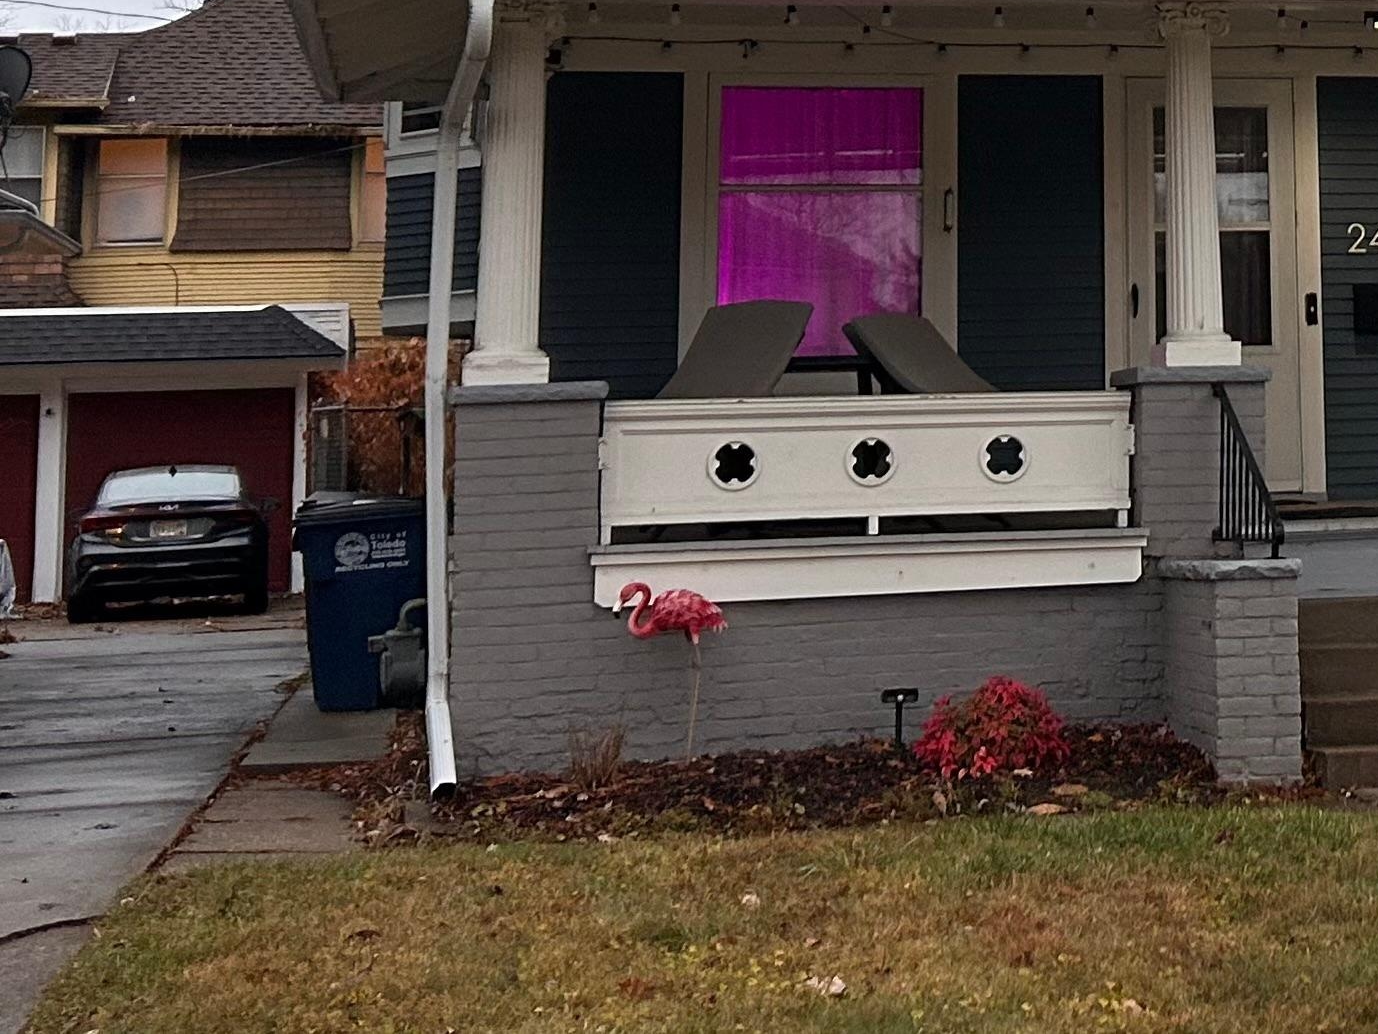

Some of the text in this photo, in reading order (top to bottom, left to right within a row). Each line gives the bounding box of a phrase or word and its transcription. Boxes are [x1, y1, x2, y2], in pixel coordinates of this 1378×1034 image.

[396, 530, 407, 539] of
[370, 539, 407, 550] Toledo
[335, 562, 385, 573] RECYCLING
